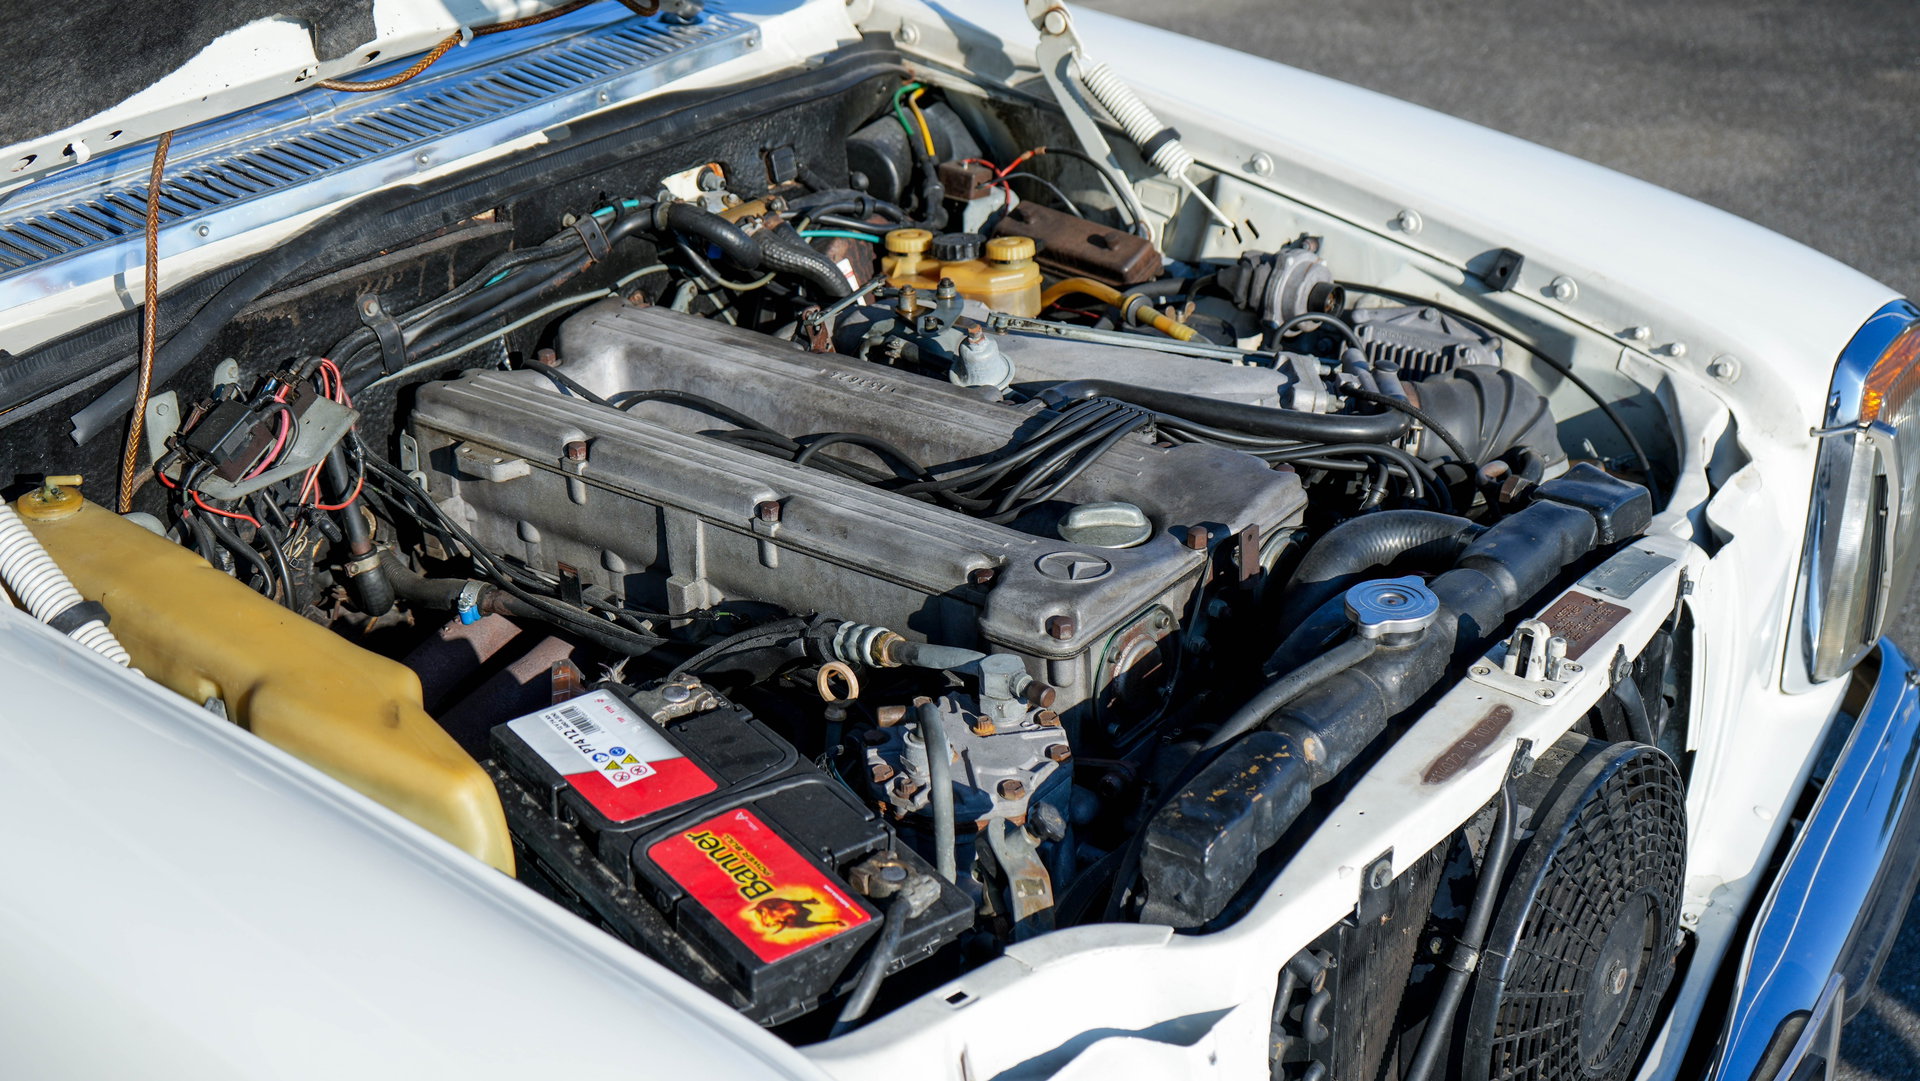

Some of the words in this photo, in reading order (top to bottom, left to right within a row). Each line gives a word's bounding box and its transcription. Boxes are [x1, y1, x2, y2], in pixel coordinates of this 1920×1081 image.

[722, 834, 743, 851] BULL
[686, 831, 774, 901] Banner
[741, 851, 771, 877] POWER
